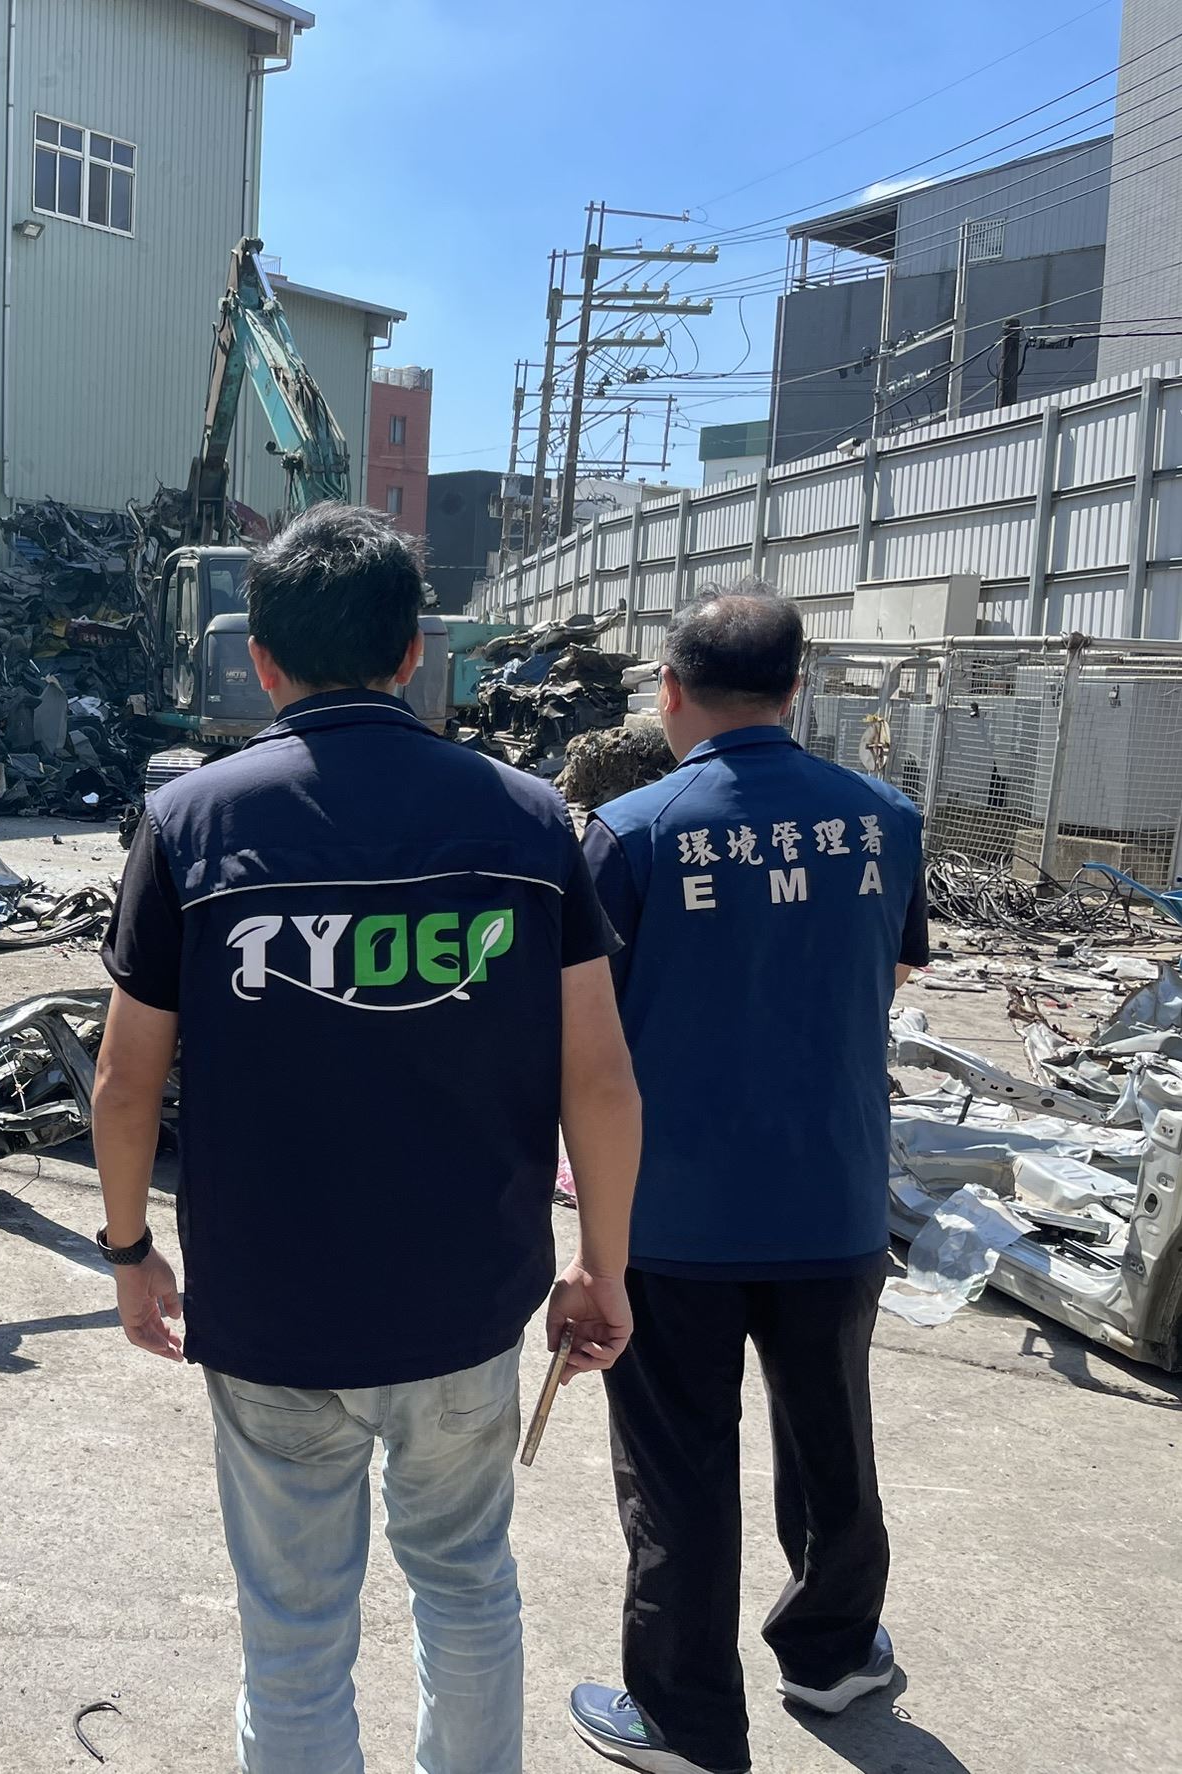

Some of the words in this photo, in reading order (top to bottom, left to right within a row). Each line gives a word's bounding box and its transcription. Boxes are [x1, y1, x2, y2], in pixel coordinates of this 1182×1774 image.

[676, 814, 884, 867] 環境管理署
[226, 908, 515, 989] TYDEP
